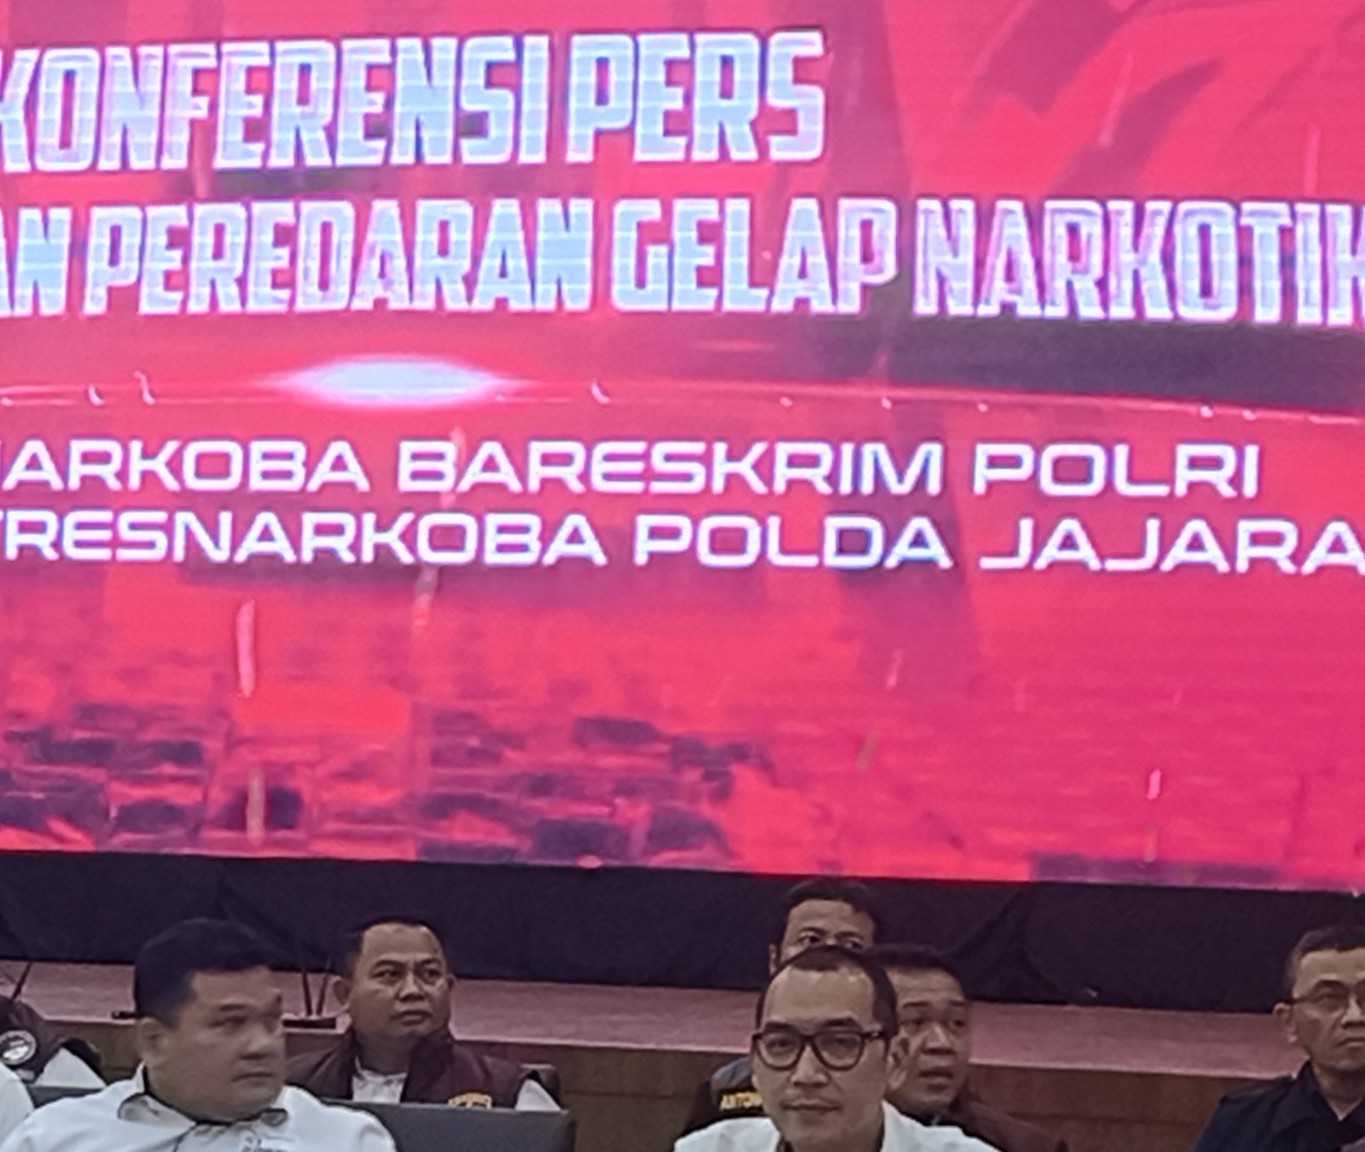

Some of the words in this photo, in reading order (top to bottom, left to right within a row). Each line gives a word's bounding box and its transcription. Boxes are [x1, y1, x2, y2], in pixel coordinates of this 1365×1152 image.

[566, 30, 826, 164] PERS
[82, 198, 593, 315] PEREDARAN
[609, 198, 898, 313] GELAP
[396, 439, 943, 495] BARESKRIM
[972, 443, 1259, 498] POLRI
[633, 514, 953, 569] POLDA
[979, 517, 1365, 574] JAJARA
